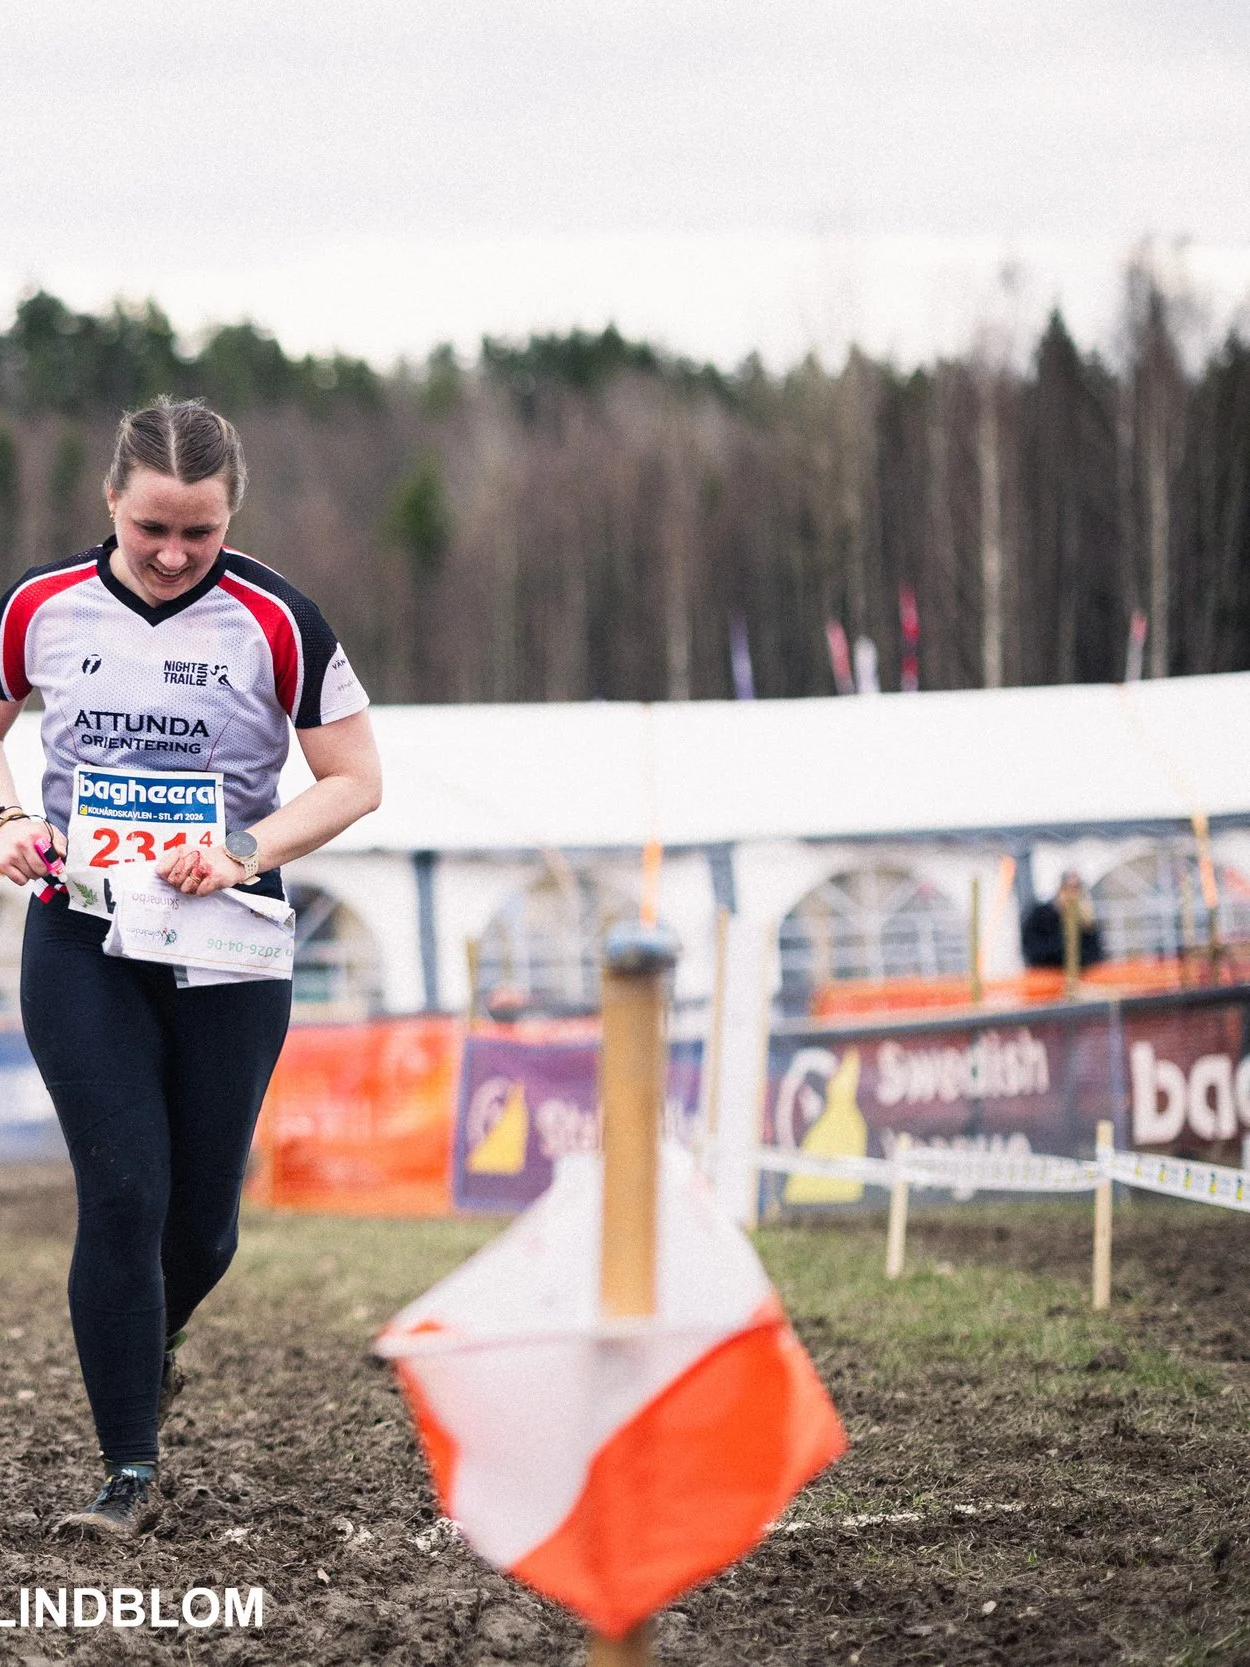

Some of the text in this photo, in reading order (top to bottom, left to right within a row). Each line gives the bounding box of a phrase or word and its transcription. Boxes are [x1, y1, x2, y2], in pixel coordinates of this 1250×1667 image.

[164, 660, 197, 673] NIGHT
[196, 663, 208, 686] RUN
[164, 672, 196, 686] TRAIL
[74, 709, 210, 738] ATTUNDA
[81, 734, 201, 754] ORIENTERING
[79, 774, 216, 806] bagheera
[88, 806, 152, 820] KOLMÅRDSKAVLEN
[159, 813, 173, 821] STL
[185, 812, 204, 821] 2026
[199, 831, 213, 848] 4
[207, 938, 282, 958] 2026-04-06
[877, 1028, 1048, 1106] Swedish
[1130, 1040, 1250, 1172] ba
